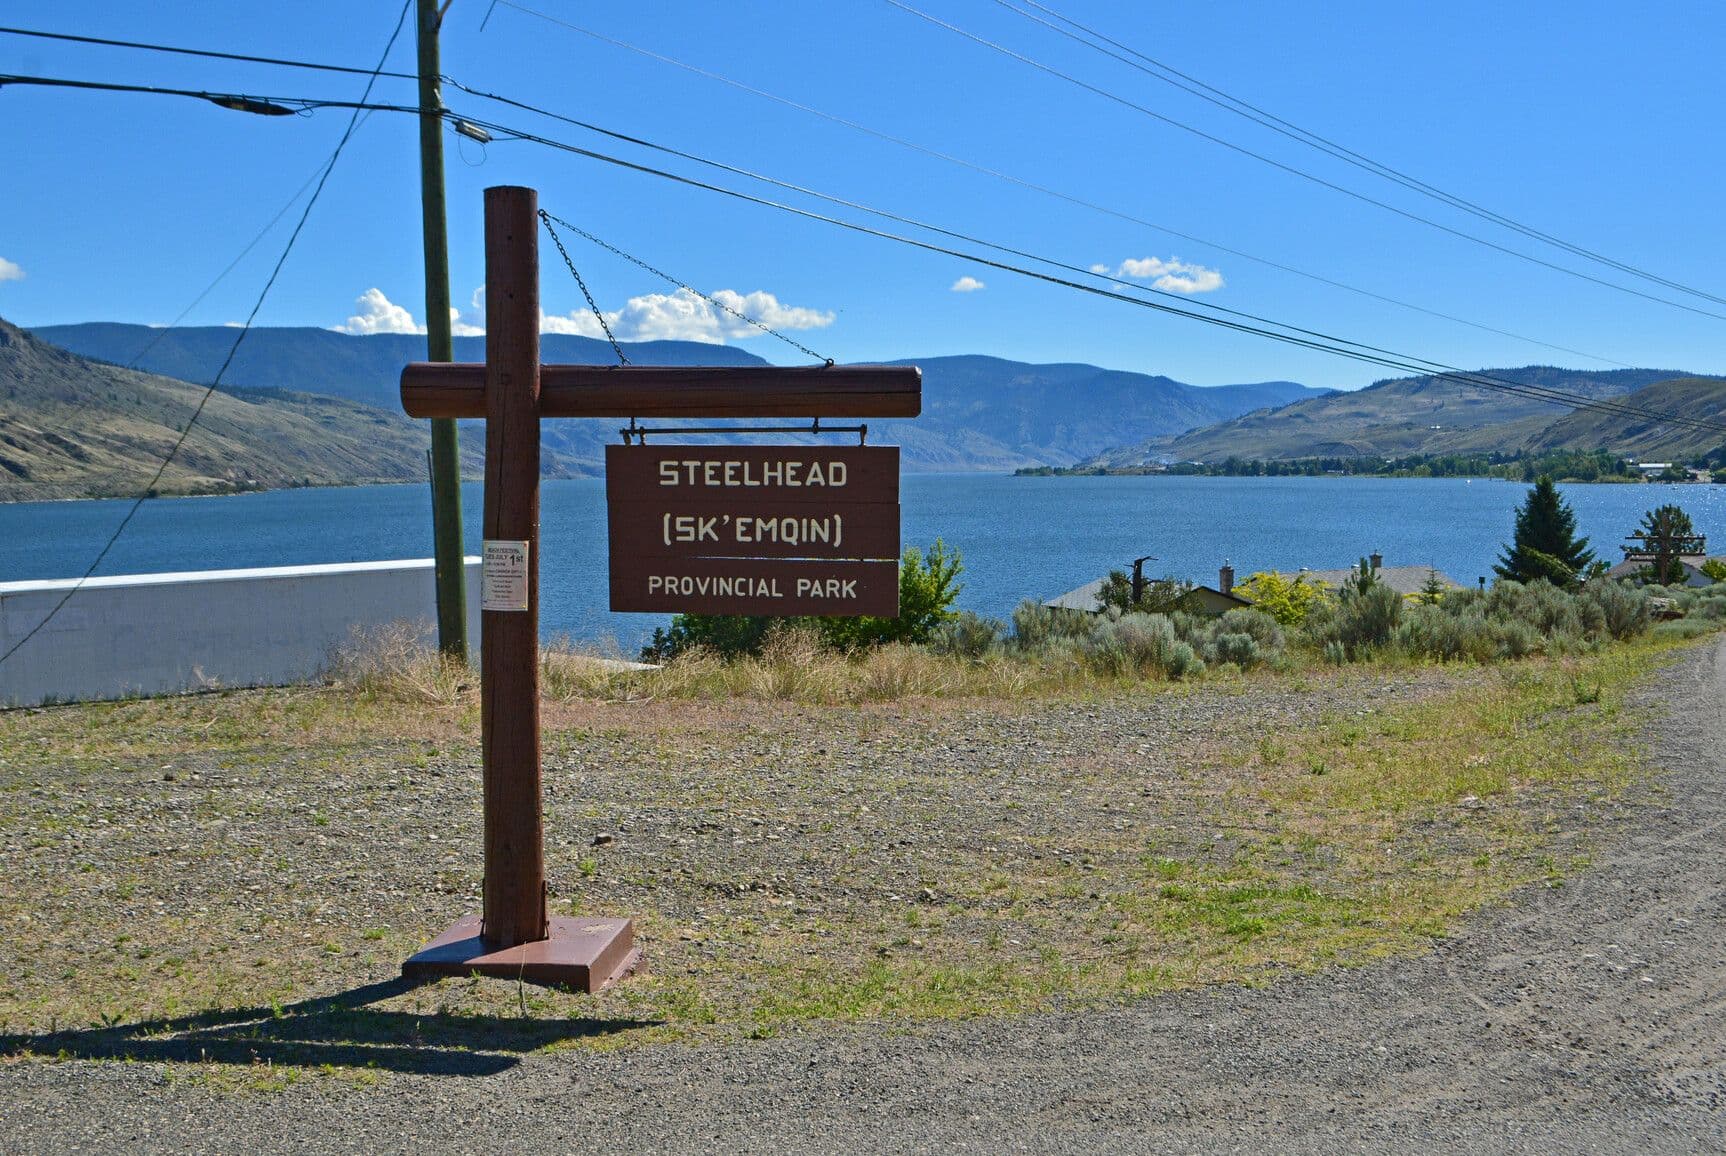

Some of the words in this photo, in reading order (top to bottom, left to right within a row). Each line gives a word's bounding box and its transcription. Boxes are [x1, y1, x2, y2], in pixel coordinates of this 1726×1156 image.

[659, 460, 847, 487] STEELHEAD
[648, 575, 784, 597] PROVINCIAL
[797, 578, 857, 599] PARK
